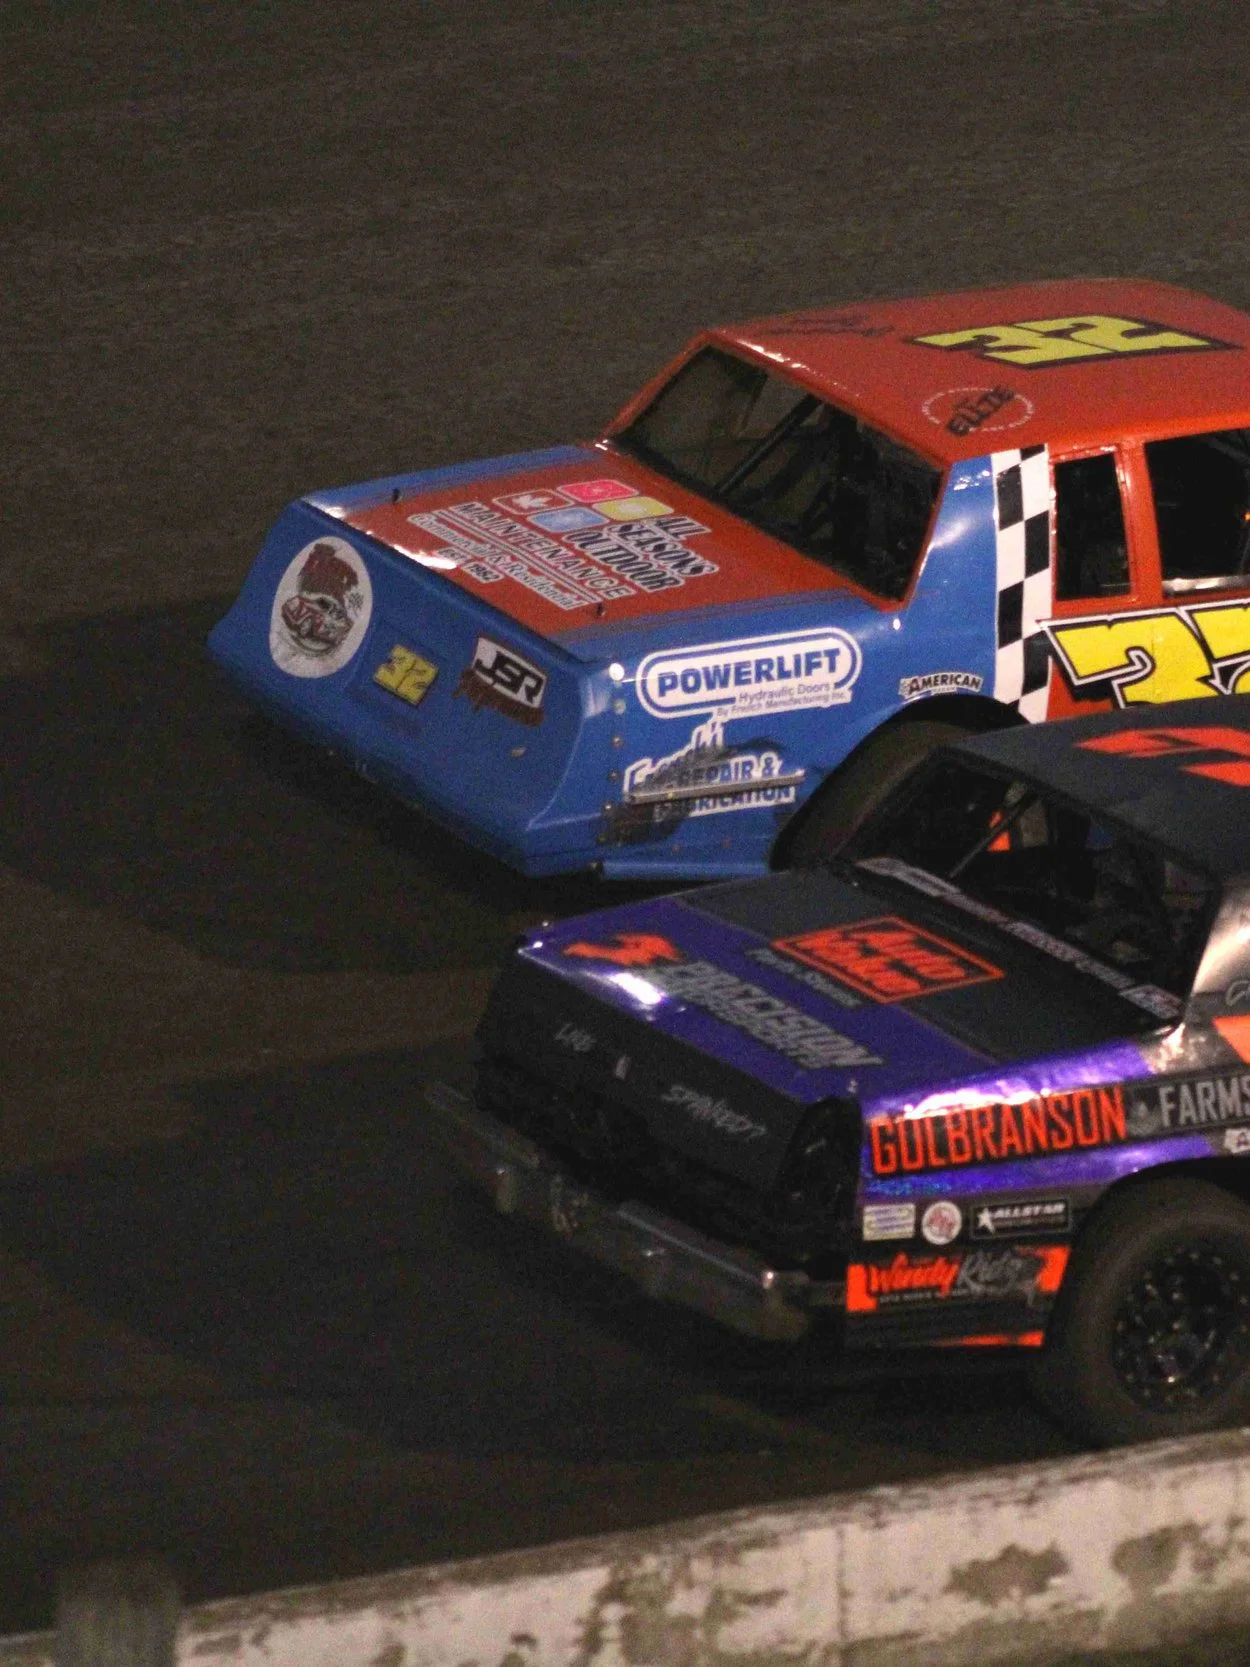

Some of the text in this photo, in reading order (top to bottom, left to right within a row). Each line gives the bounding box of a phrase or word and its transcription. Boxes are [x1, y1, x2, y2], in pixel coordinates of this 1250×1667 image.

[910, 313, 1215, 366] 32
[453, 502, 635, 599] MAINTENANCE
[609, 522, 718, 576] SEASONS
[654, 516, 707, 539] ALL
[566, 530, 684, 591] OUTDOOR
[657, 647, 841, 698] POWERLIFT
[738, 682, 831, 706] Hydraulic Doors
[907, 673, 981, 695] AMERICAN
[716, 705, 730, 719] By
[869, 1084, 1128, 1175] GULBRANSON
[990, 1202, 1066, 1220] ALLSTAR
